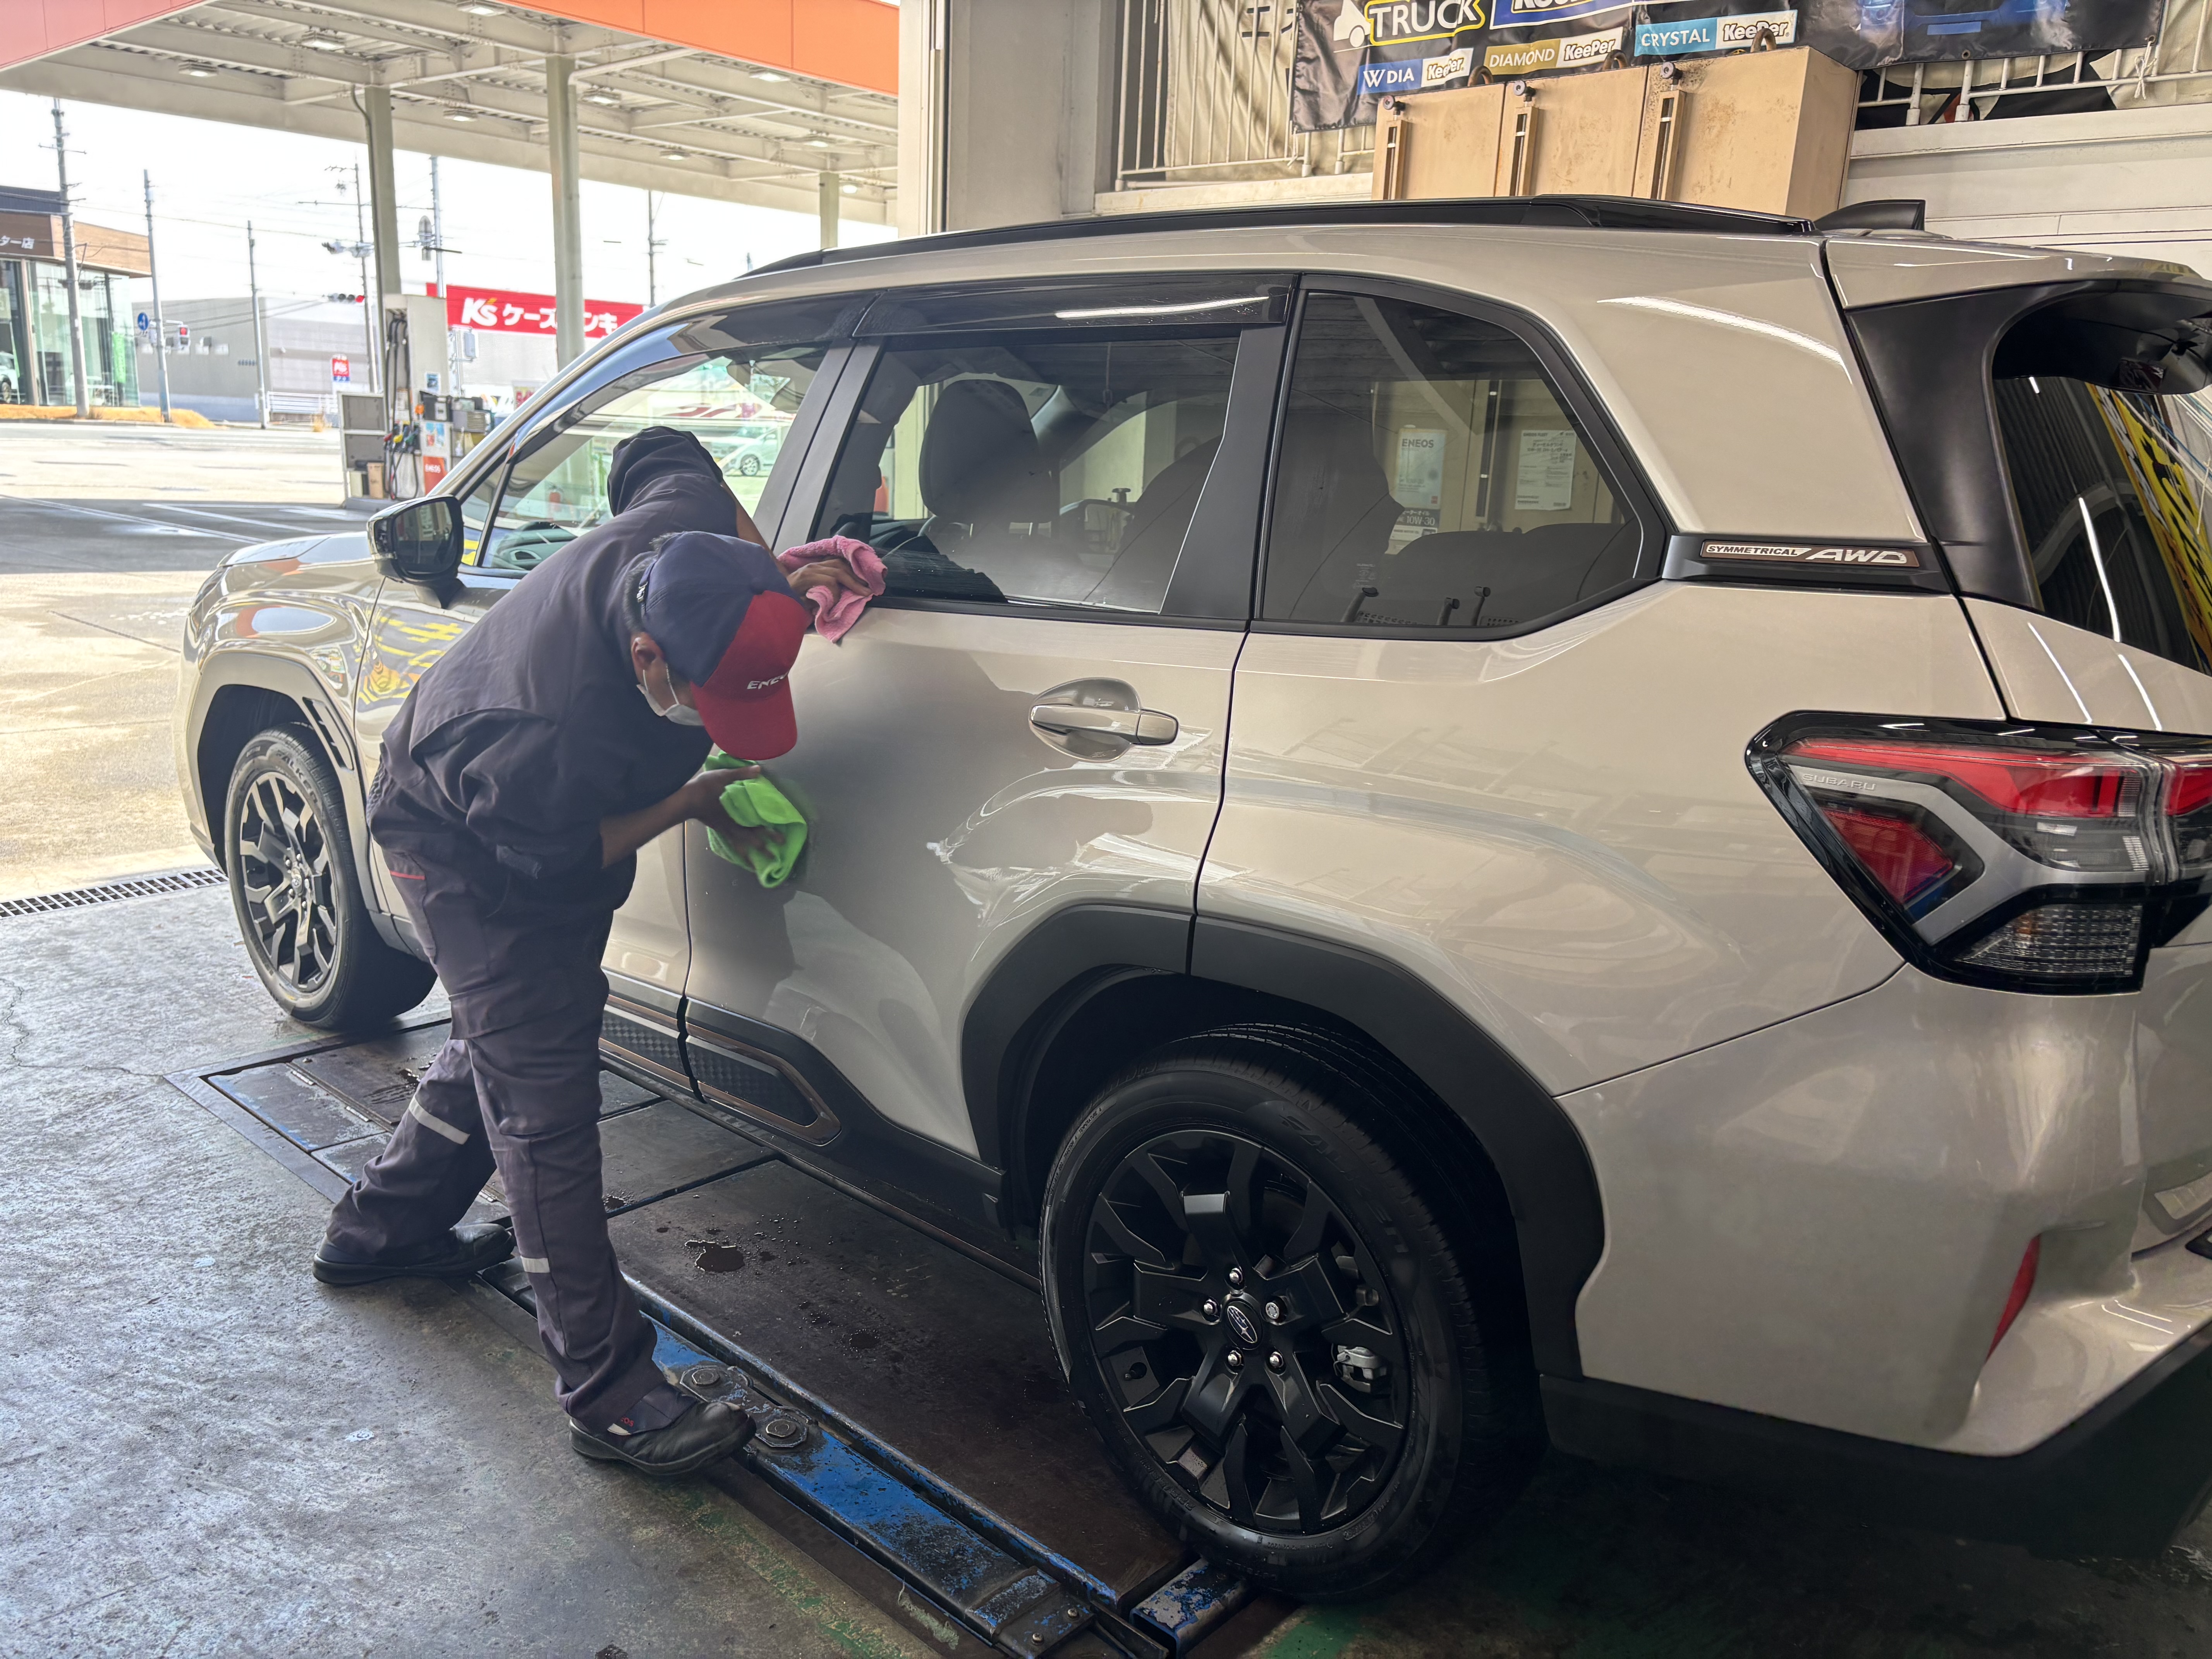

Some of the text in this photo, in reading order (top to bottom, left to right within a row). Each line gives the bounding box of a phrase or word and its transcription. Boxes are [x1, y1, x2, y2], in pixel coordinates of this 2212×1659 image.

[1369, 0, 1477, 38] TRUCK
[1641, 27, 1710, 48] CRYSTAL
[1489, 38, 1616, 68] DIAMOND KeePer
[1387, 68, 1415, 84] DIA
[1401, 438, 1434, 448] ENEOS
[1406, 515, 1435, 526] 10W-30
[1708, 545, 1907, 564] SYMMETRICAL AWD
[1802, 773, 1876, 791] SUBARU
